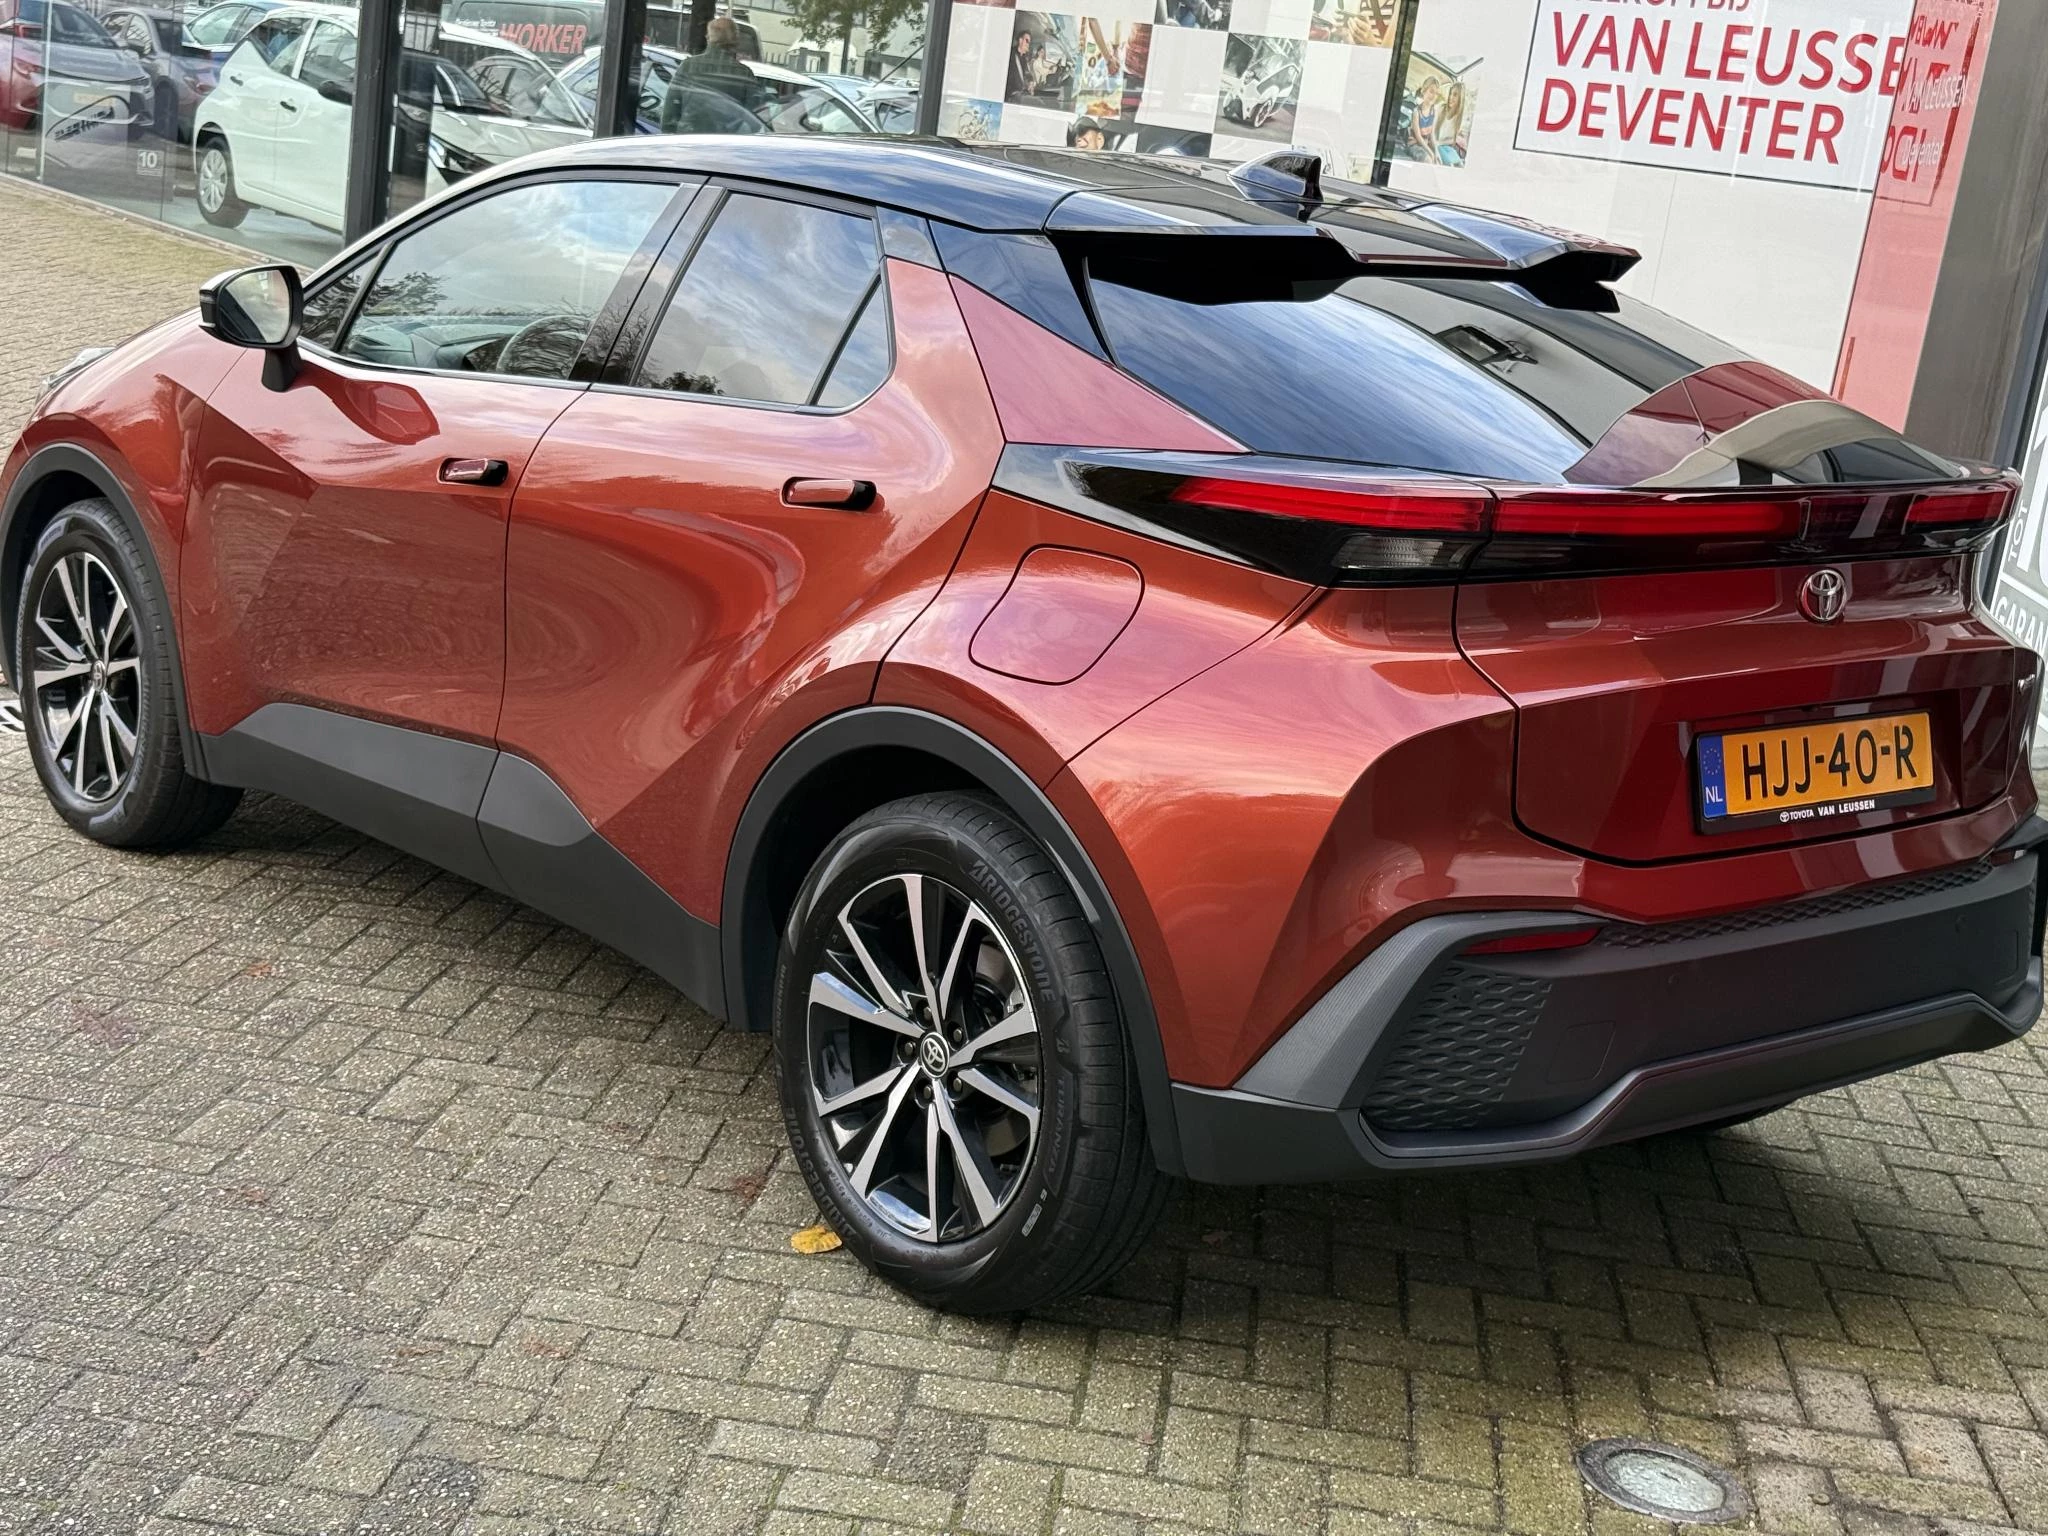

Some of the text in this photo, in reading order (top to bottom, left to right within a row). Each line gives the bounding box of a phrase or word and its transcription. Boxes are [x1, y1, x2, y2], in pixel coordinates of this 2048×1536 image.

[499, 22, 588, 55] WORKER
[1552, 11, 1672, 76] VAN
[1536, 78, 1846, 165] DEVENTER
[138, 151, 158, 169] 10
[2008, 499, 2028, 562] TOT
[1742, 725, 1918, 801] HJJ-40-R
[1704, 786, 1724, 804] NL
[1789, 799, 1876, 821] TOYOTA VAN LEUSSEN
[967, 858, 1055, 1004] BRIDGESTONE
